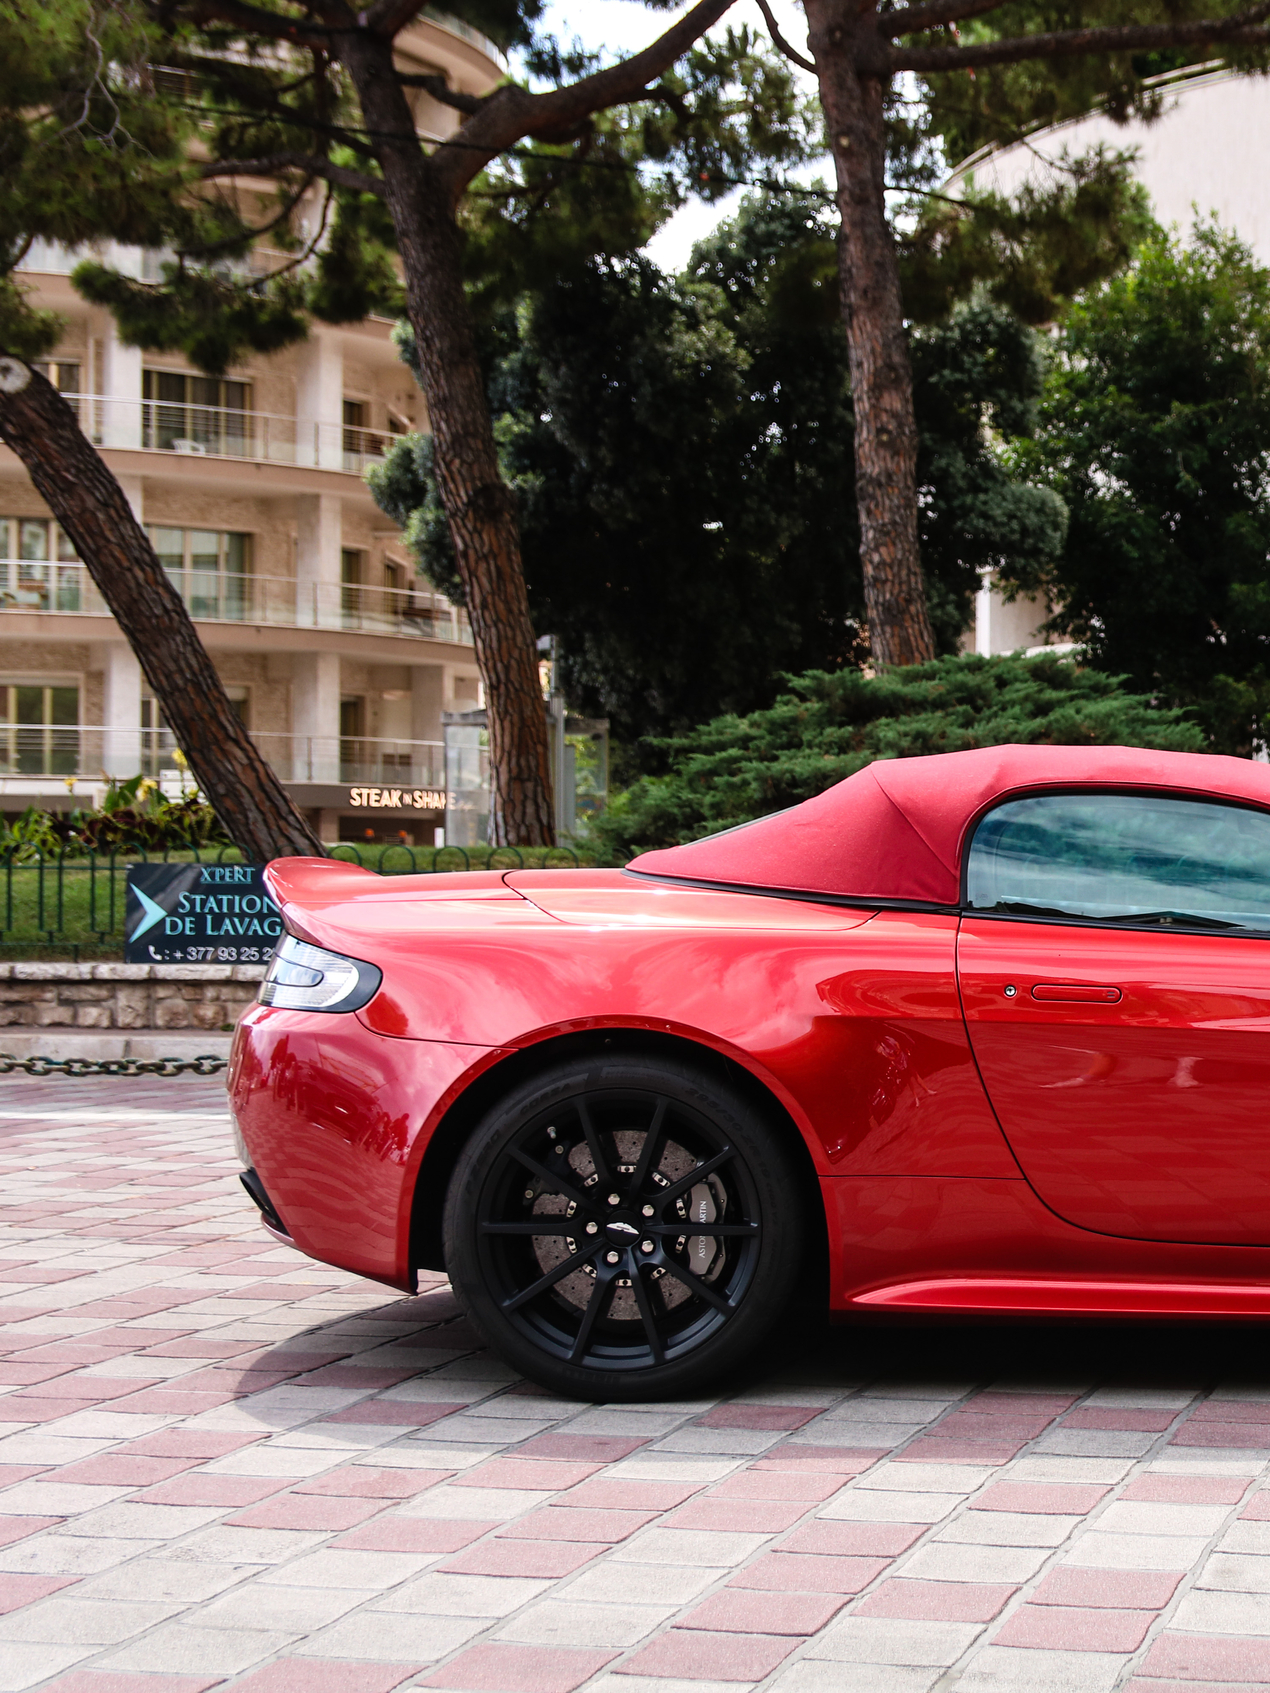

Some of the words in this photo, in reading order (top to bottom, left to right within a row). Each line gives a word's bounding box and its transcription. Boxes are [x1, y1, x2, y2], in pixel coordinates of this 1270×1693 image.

[349, 787, 402, 808] STEAK
[177, 890, 280, 914] STATION
[164, 916, 196, 936] DE
[205, 913, 282, 937] LAVAG
[186, 946, 215, 961] 377
[217, 946, 238, 961] 93
[240, 946, 260, 961] 25
[699, 1200, 707, 1223] ARTIN
